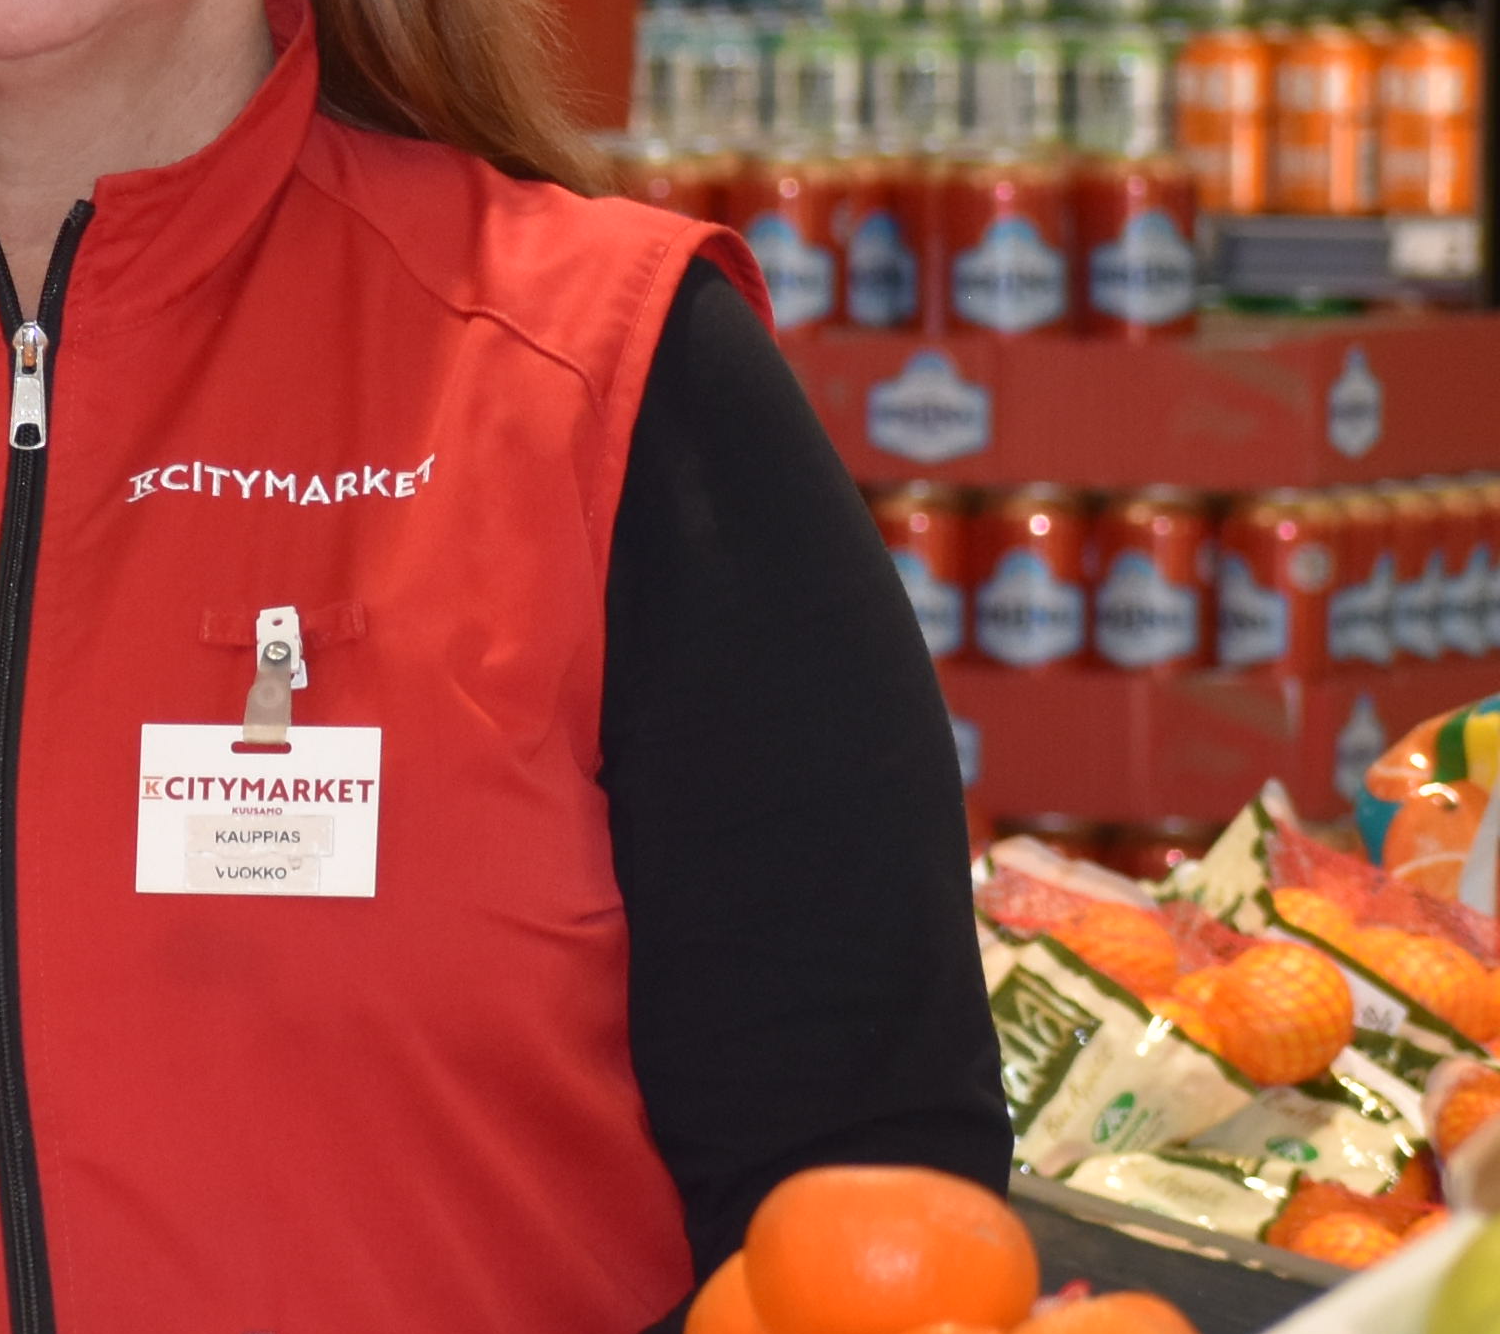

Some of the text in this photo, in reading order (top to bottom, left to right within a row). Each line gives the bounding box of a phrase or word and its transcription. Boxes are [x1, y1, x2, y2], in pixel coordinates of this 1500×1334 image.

[231, 807, 283, 816] KUUSAMO
[215, 830, 301, 844] KAUPPIAS
[216, 866, 287, 880] VUOKKO
